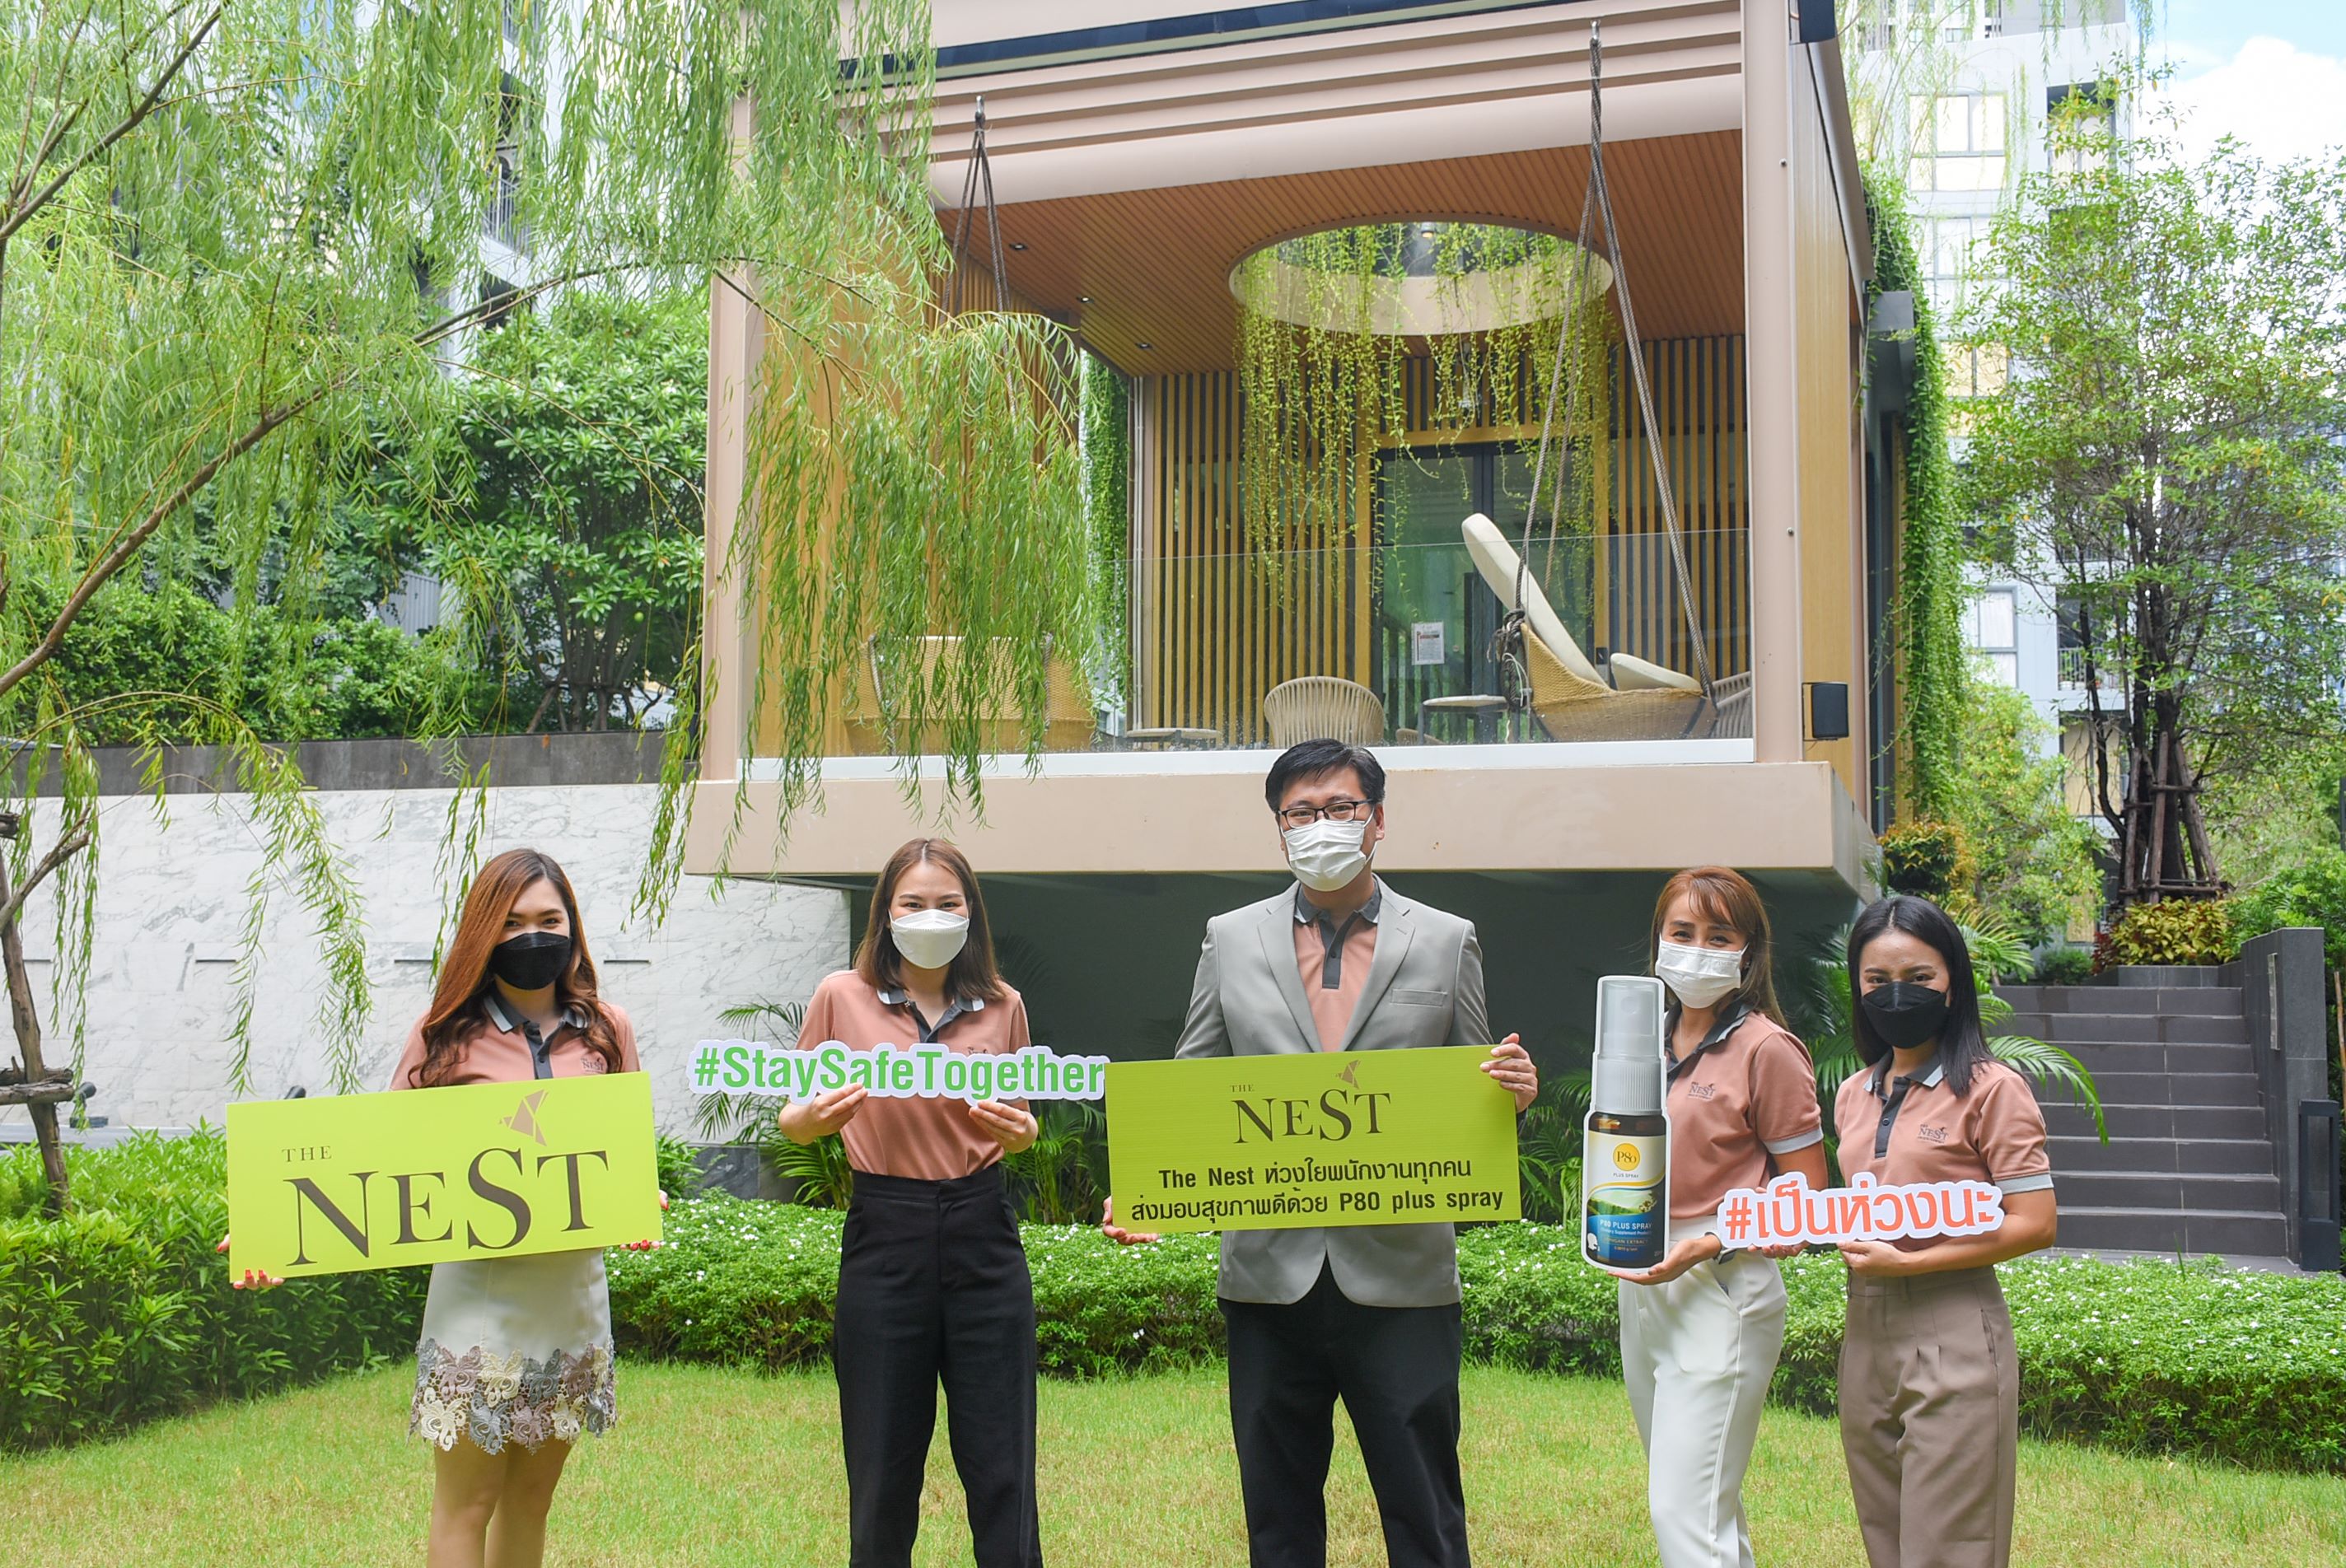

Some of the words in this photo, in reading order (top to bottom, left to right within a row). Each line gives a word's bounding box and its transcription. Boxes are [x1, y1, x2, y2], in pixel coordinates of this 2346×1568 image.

[694, 1046, 1104, 1100] #StaySafeTogether
[1229, 1084, 1255, 1094] THE
[1230, 1088, 1392, 1145] NEST
[281, 1145, 333, 1164] THE
[1158, 1169, 1197, 1189] The
[1208, 1166, 1255, 1187] Nest
[1264, 1156, 1473, 1185] ห่วงใยพนักงานทุกคน
[282, 1146, 610, 1267] NEST
[1131, 1187, 1329, 1224] ส่งมอบสุขภาพดีด้วย
[1339, 1191, 1381, 1212] P80
[1392, 1189, 1436, 1214] plus
[1446, 1188, 1504, 1211] spray
[1724, 1178, 1995, 1240] #เป็นห่วงนะ
